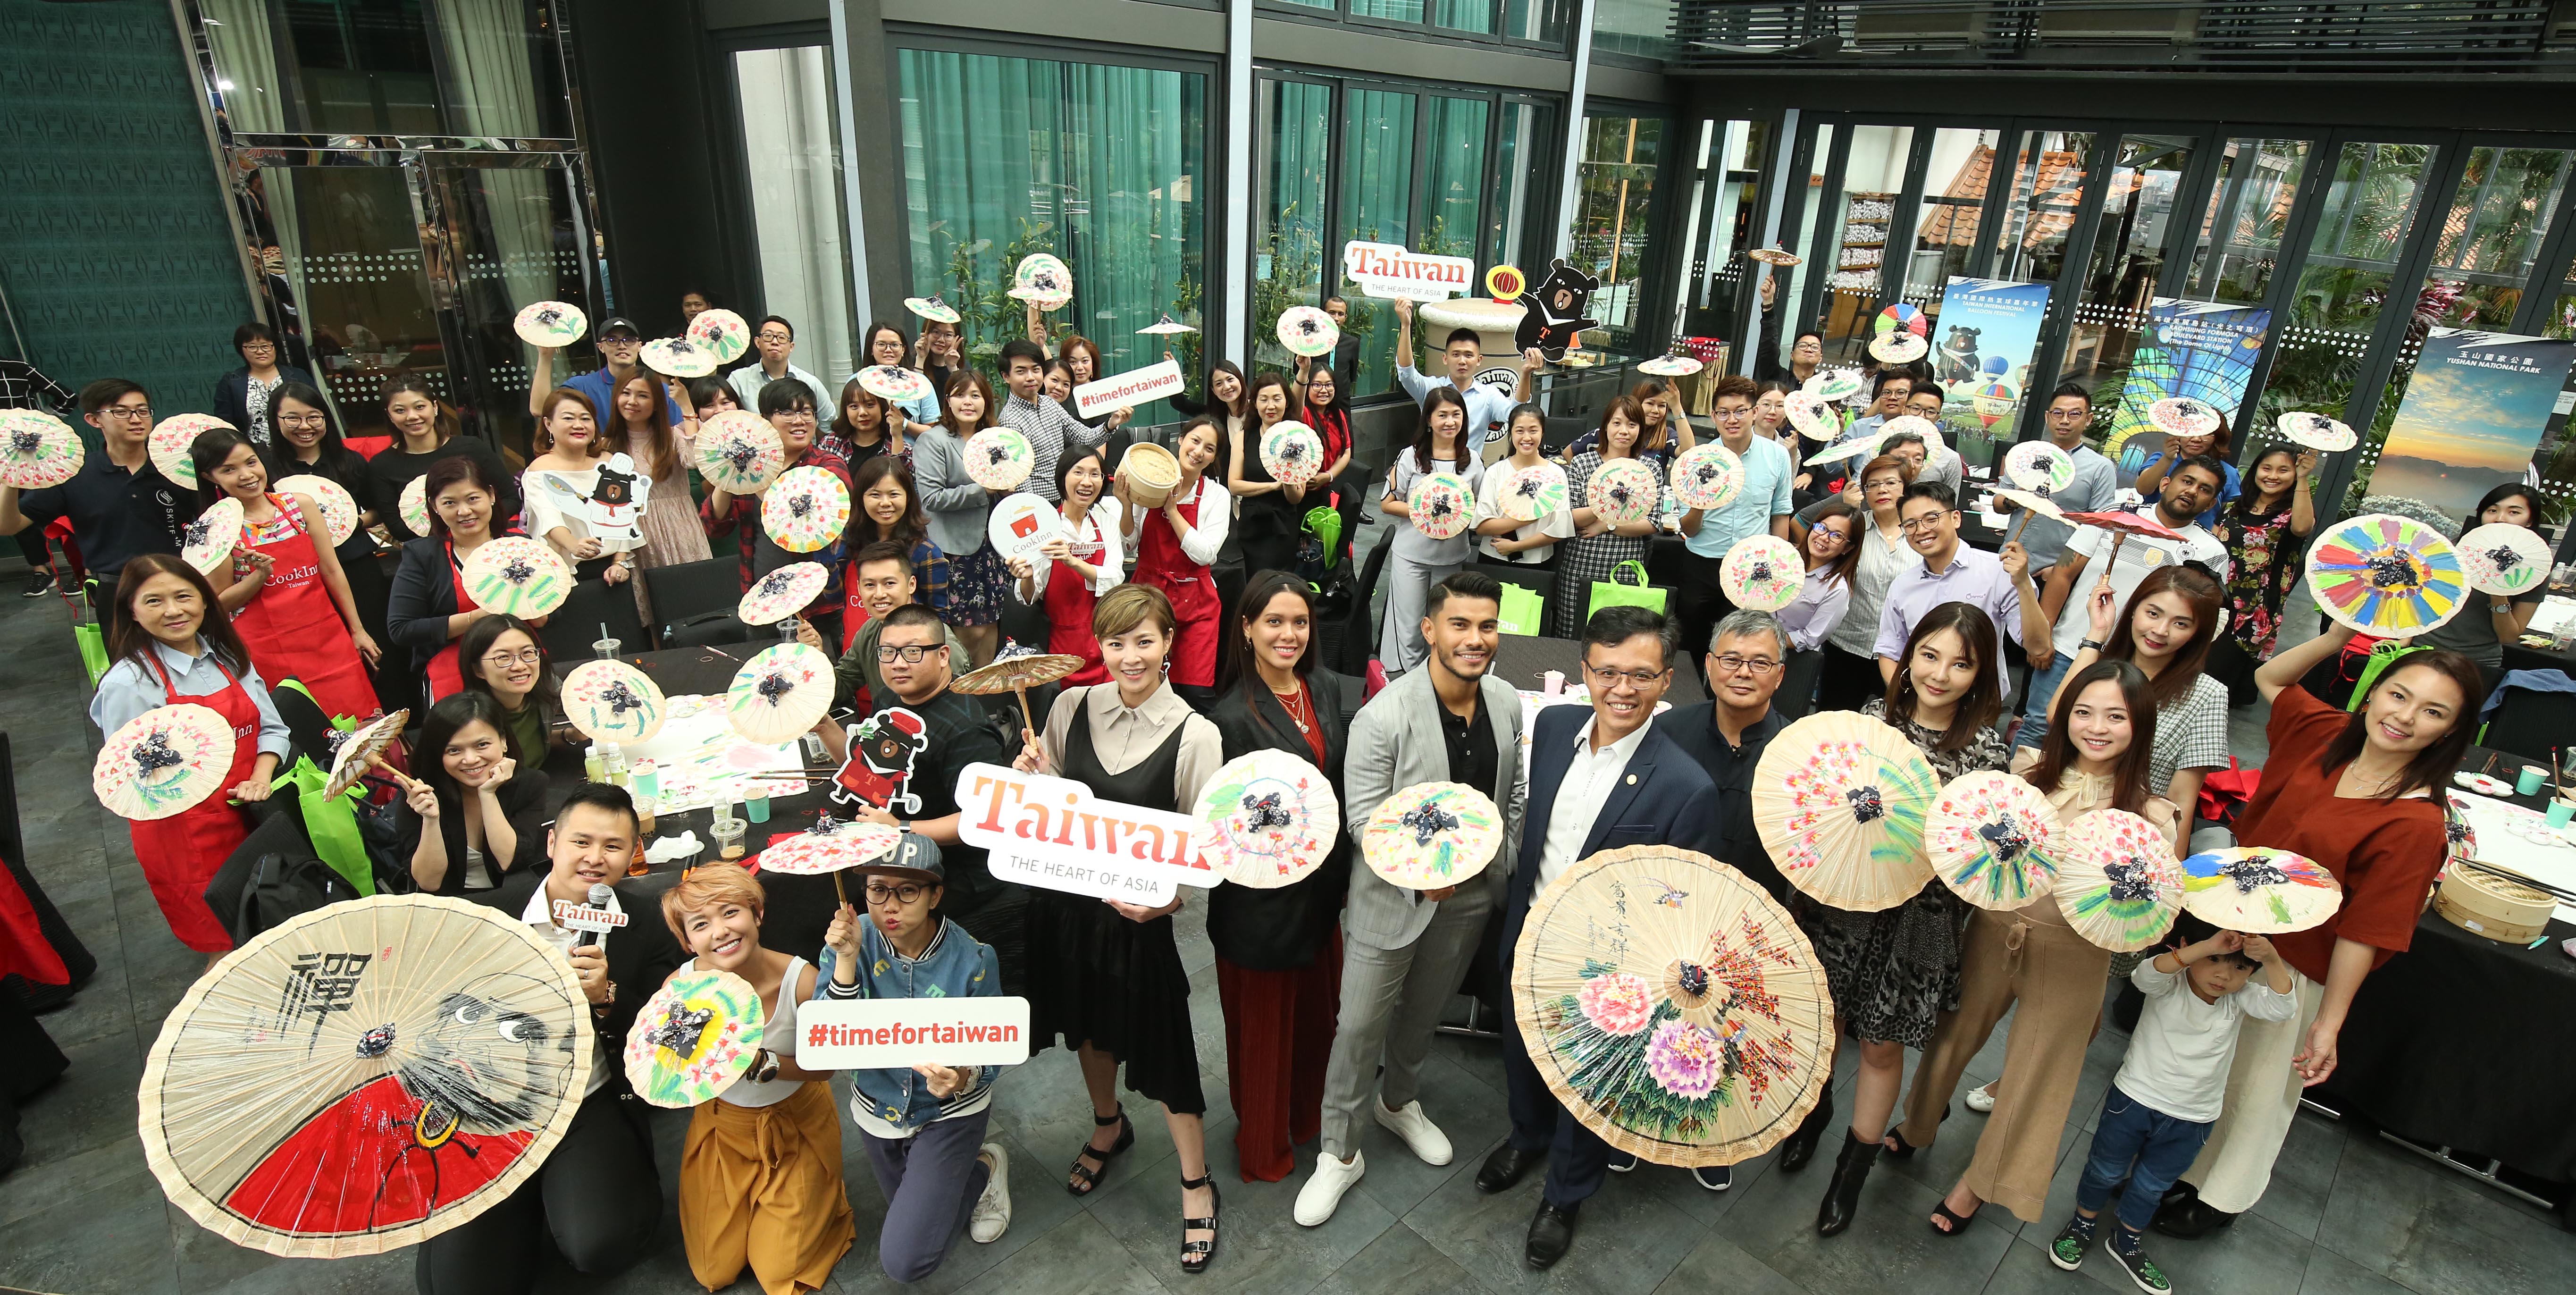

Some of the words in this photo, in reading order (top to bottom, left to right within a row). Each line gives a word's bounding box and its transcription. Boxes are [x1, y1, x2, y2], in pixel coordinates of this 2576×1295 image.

[1352, 247, 1465, 283] Taiwan
[1387, 286, 1411, 294] HEART
[1984, 303, 2025, 312] INTERNATIONAL
[1539, 326, 1551, 339] T
[2169, 325, 2206, 334] KAOHSIUNG
[2207, 329, 2239, 338] FORMOSA
[2170, 332, 2206, 341] BOULEVARD
[2184, 339, 2202, 347] Dome
[2459, 351, 2534, 366] 玉山國家公園
[2446, 357, 2477, 366] YUSHAN
[2478, 362, 2518, 371] NATIONAL
[2519, 366, 2541, 374] PARK
[1082, 374, 1177, 407] #timefortaiwan
[1013, 531, 1053, 554] CookInn
[1068, 542, 1103, 550] Taiwan
[287, 580, 310, 589] Taiwan
[865, 773, 877, 786] T
[1010, 855, 1040, 872] THE
[1044, 862, 1095, 882] HEART
[1099, 872, 1120, 886] OF
[1124, 876, 1158, 894] ASIA
[555, 901, 625, 925] Taiwan
[808, 1021, 1018, 1047] #timefortaiwan
